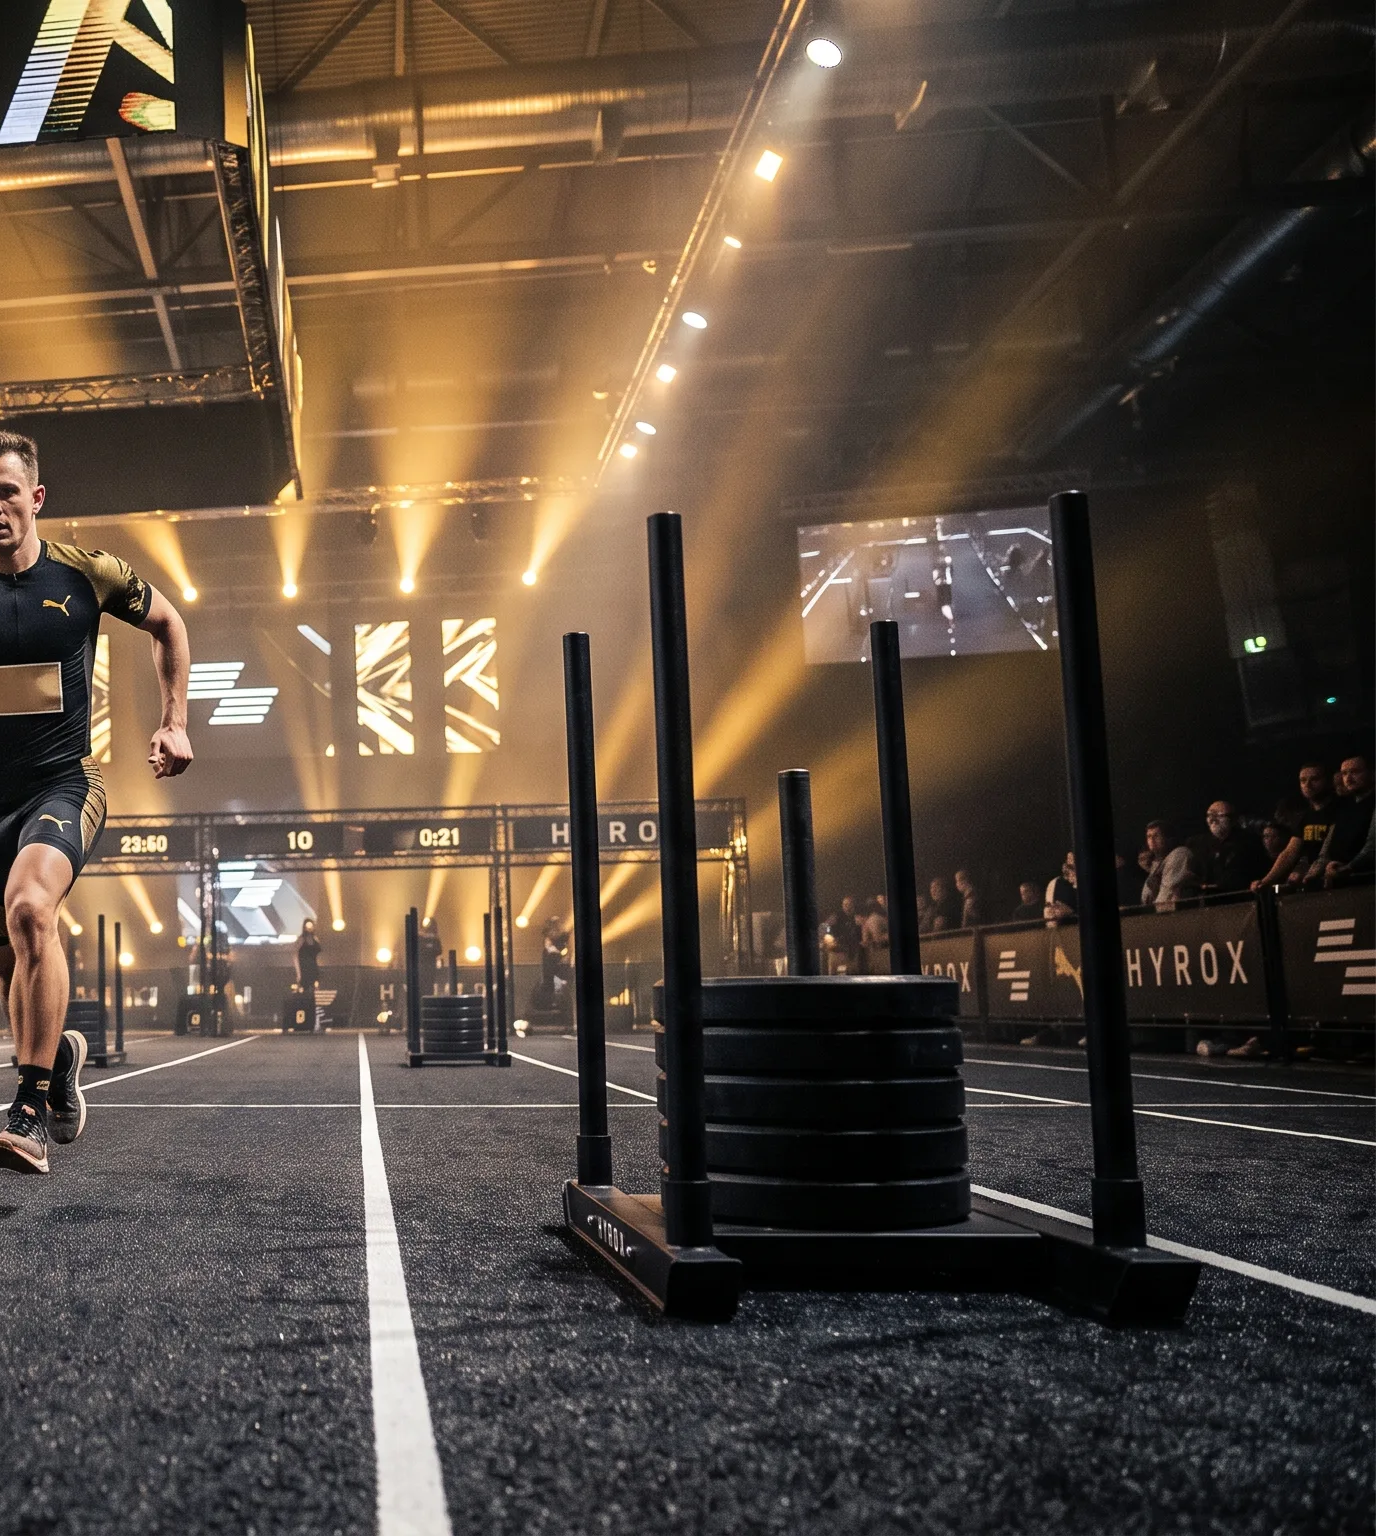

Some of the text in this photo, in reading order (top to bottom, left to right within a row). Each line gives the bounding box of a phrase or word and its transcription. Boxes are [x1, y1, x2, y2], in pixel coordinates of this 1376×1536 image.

[287, 831, 314, 850] 10
[419, 827, 460, 847] 0:21
[551, 820, 657, 844] HRO
[1126, 940, 1248, 987] HYROX
